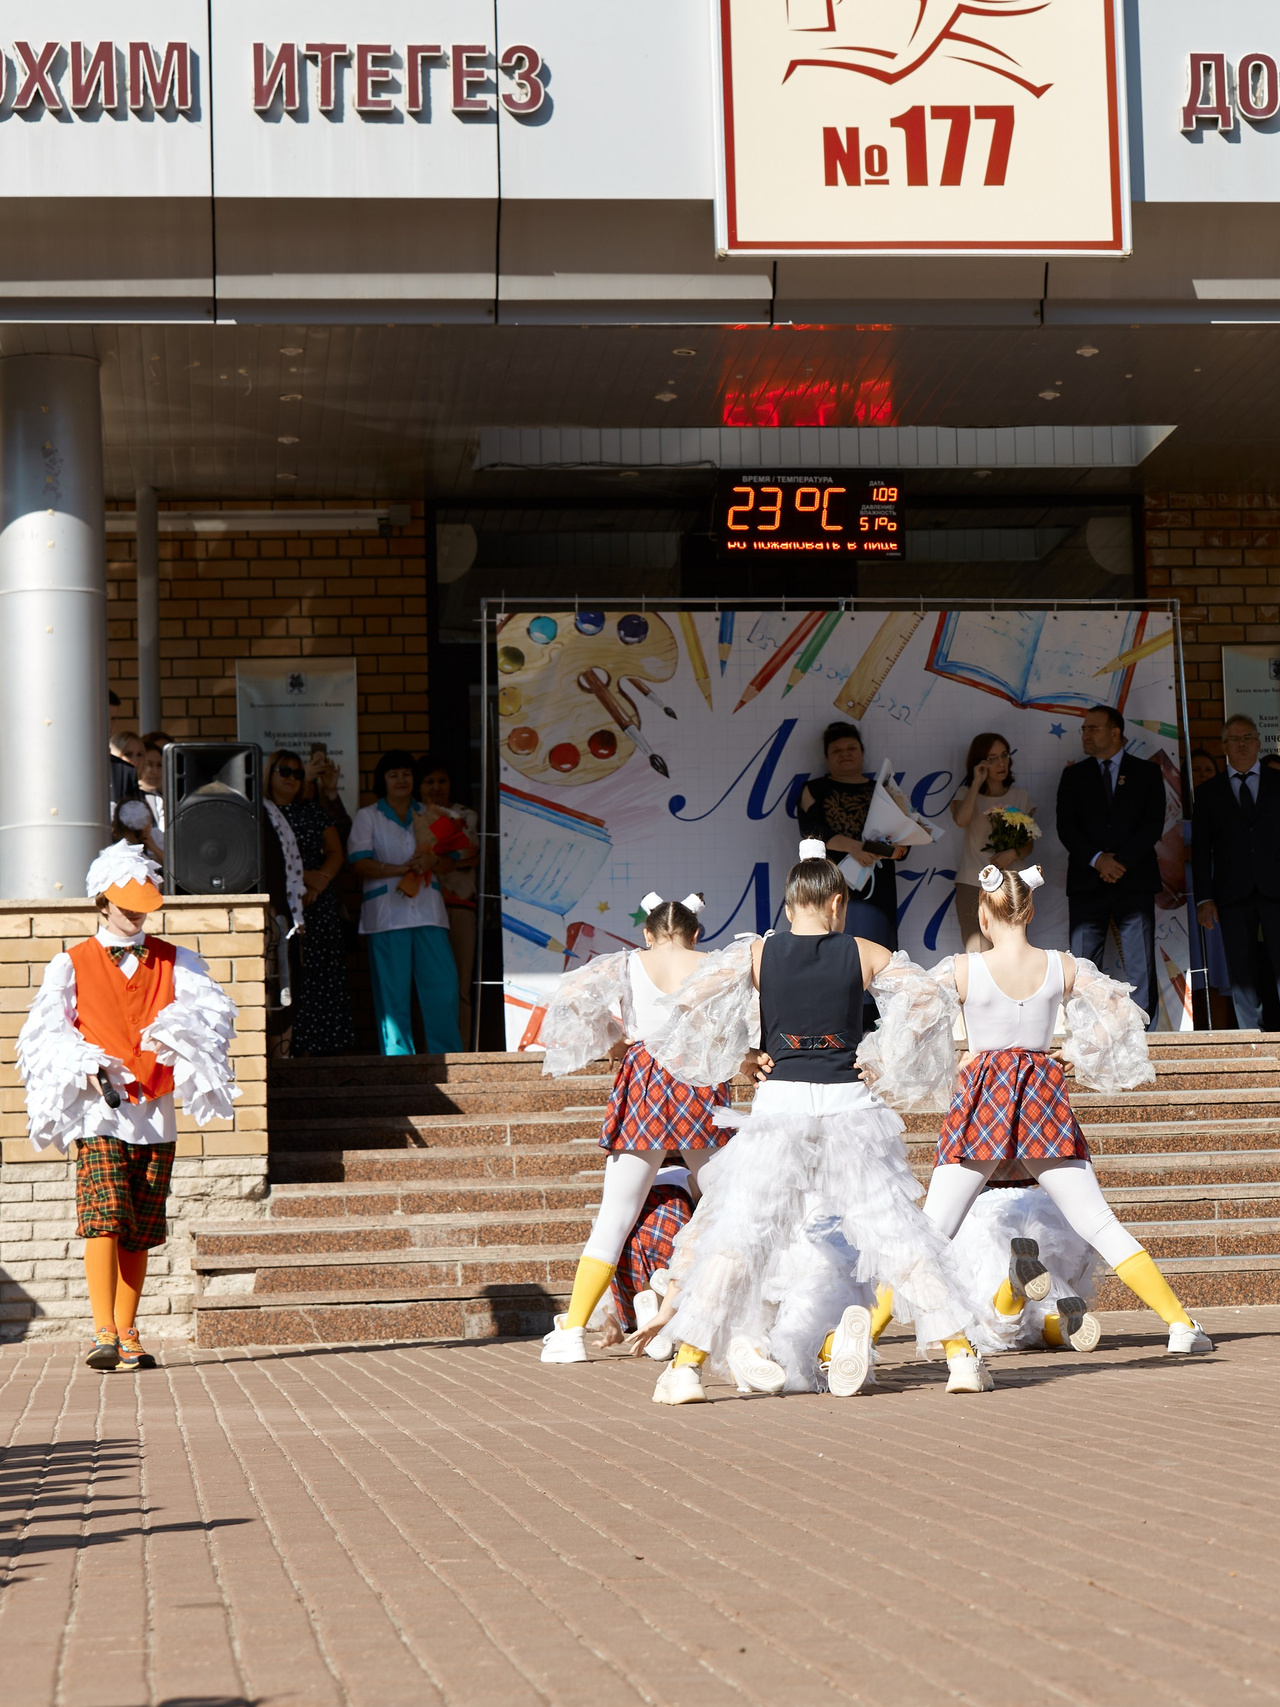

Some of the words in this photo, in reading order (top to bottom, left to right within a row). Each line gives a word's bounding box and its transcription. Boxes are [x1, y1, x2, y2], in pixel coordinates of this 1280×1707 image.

[0, 41, 191, 114] ХИМ
[252, 42, 544, 117] ИТЕГЕЗ
[742, 475, 771, 483] ВРЕМЯ
[776, 476, 834, 484] ТЕМПЕРАТУРА
[872, 487, 898, 502] 1.09
